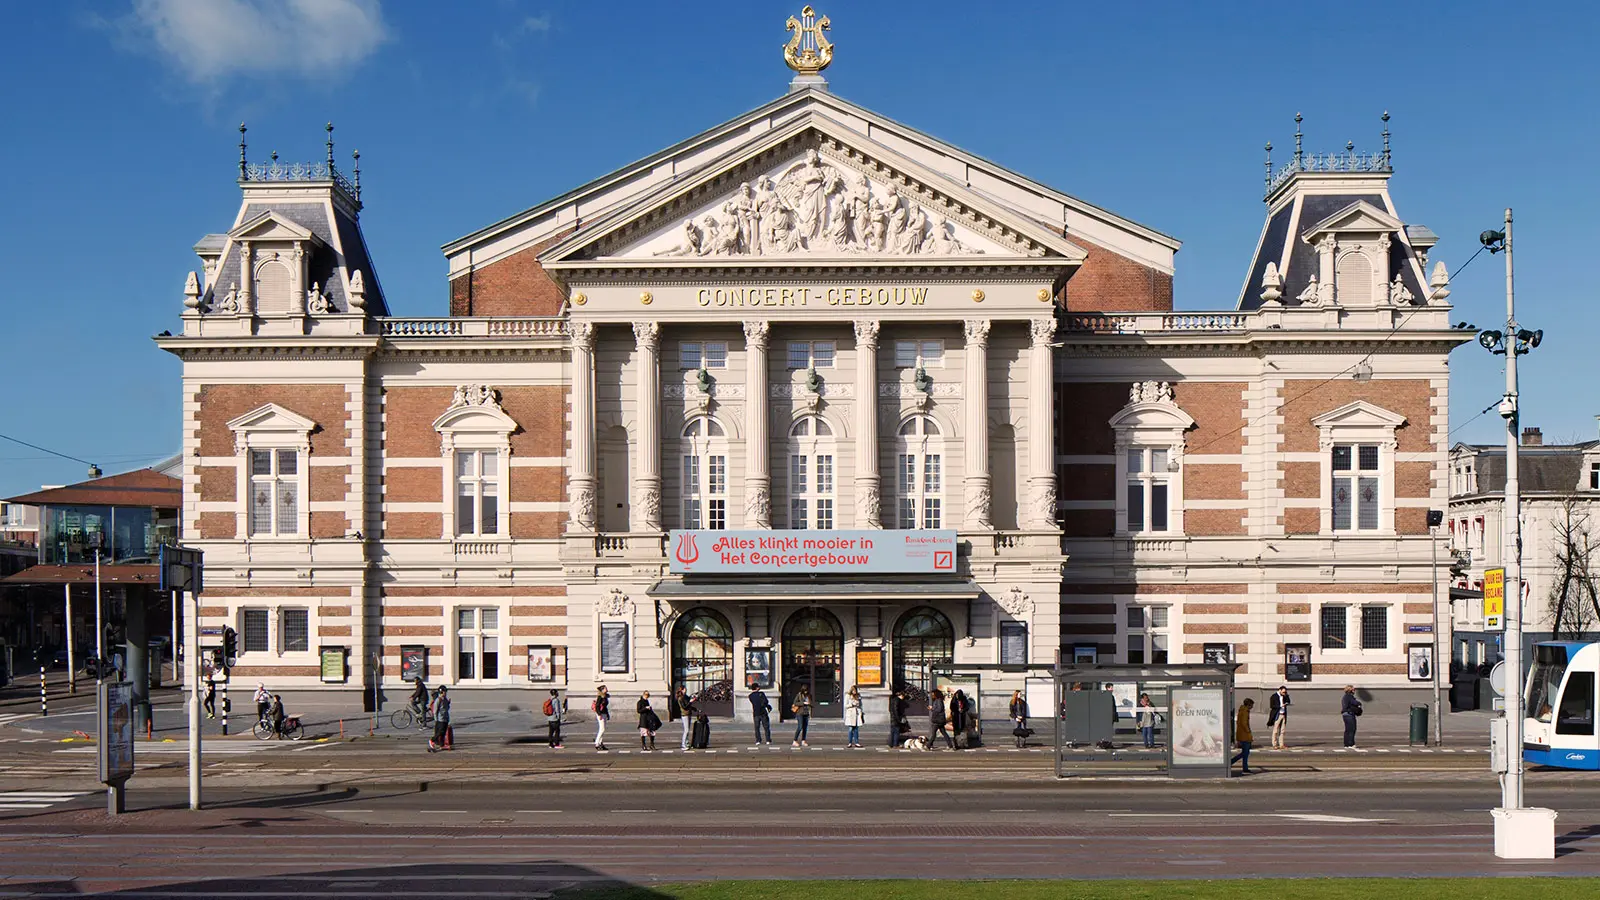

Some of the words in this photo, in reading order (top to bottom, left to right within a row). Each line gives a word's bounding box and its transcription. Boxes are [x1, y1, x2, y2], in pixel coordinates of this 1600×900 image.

[697, 287, 929, 306] CONCERT-GEBOUW
[712, 537, 755, 552] Alles
[758, 537, 798, 552] klinkt
[803, 537, 856, 549] mooier
[860, 537, 872, 549] in
[721, 552, 746, 564] Het
[750, 552, 869, 567] Concertgebouw
[1486, 587, 1503, 598] RECLAME
